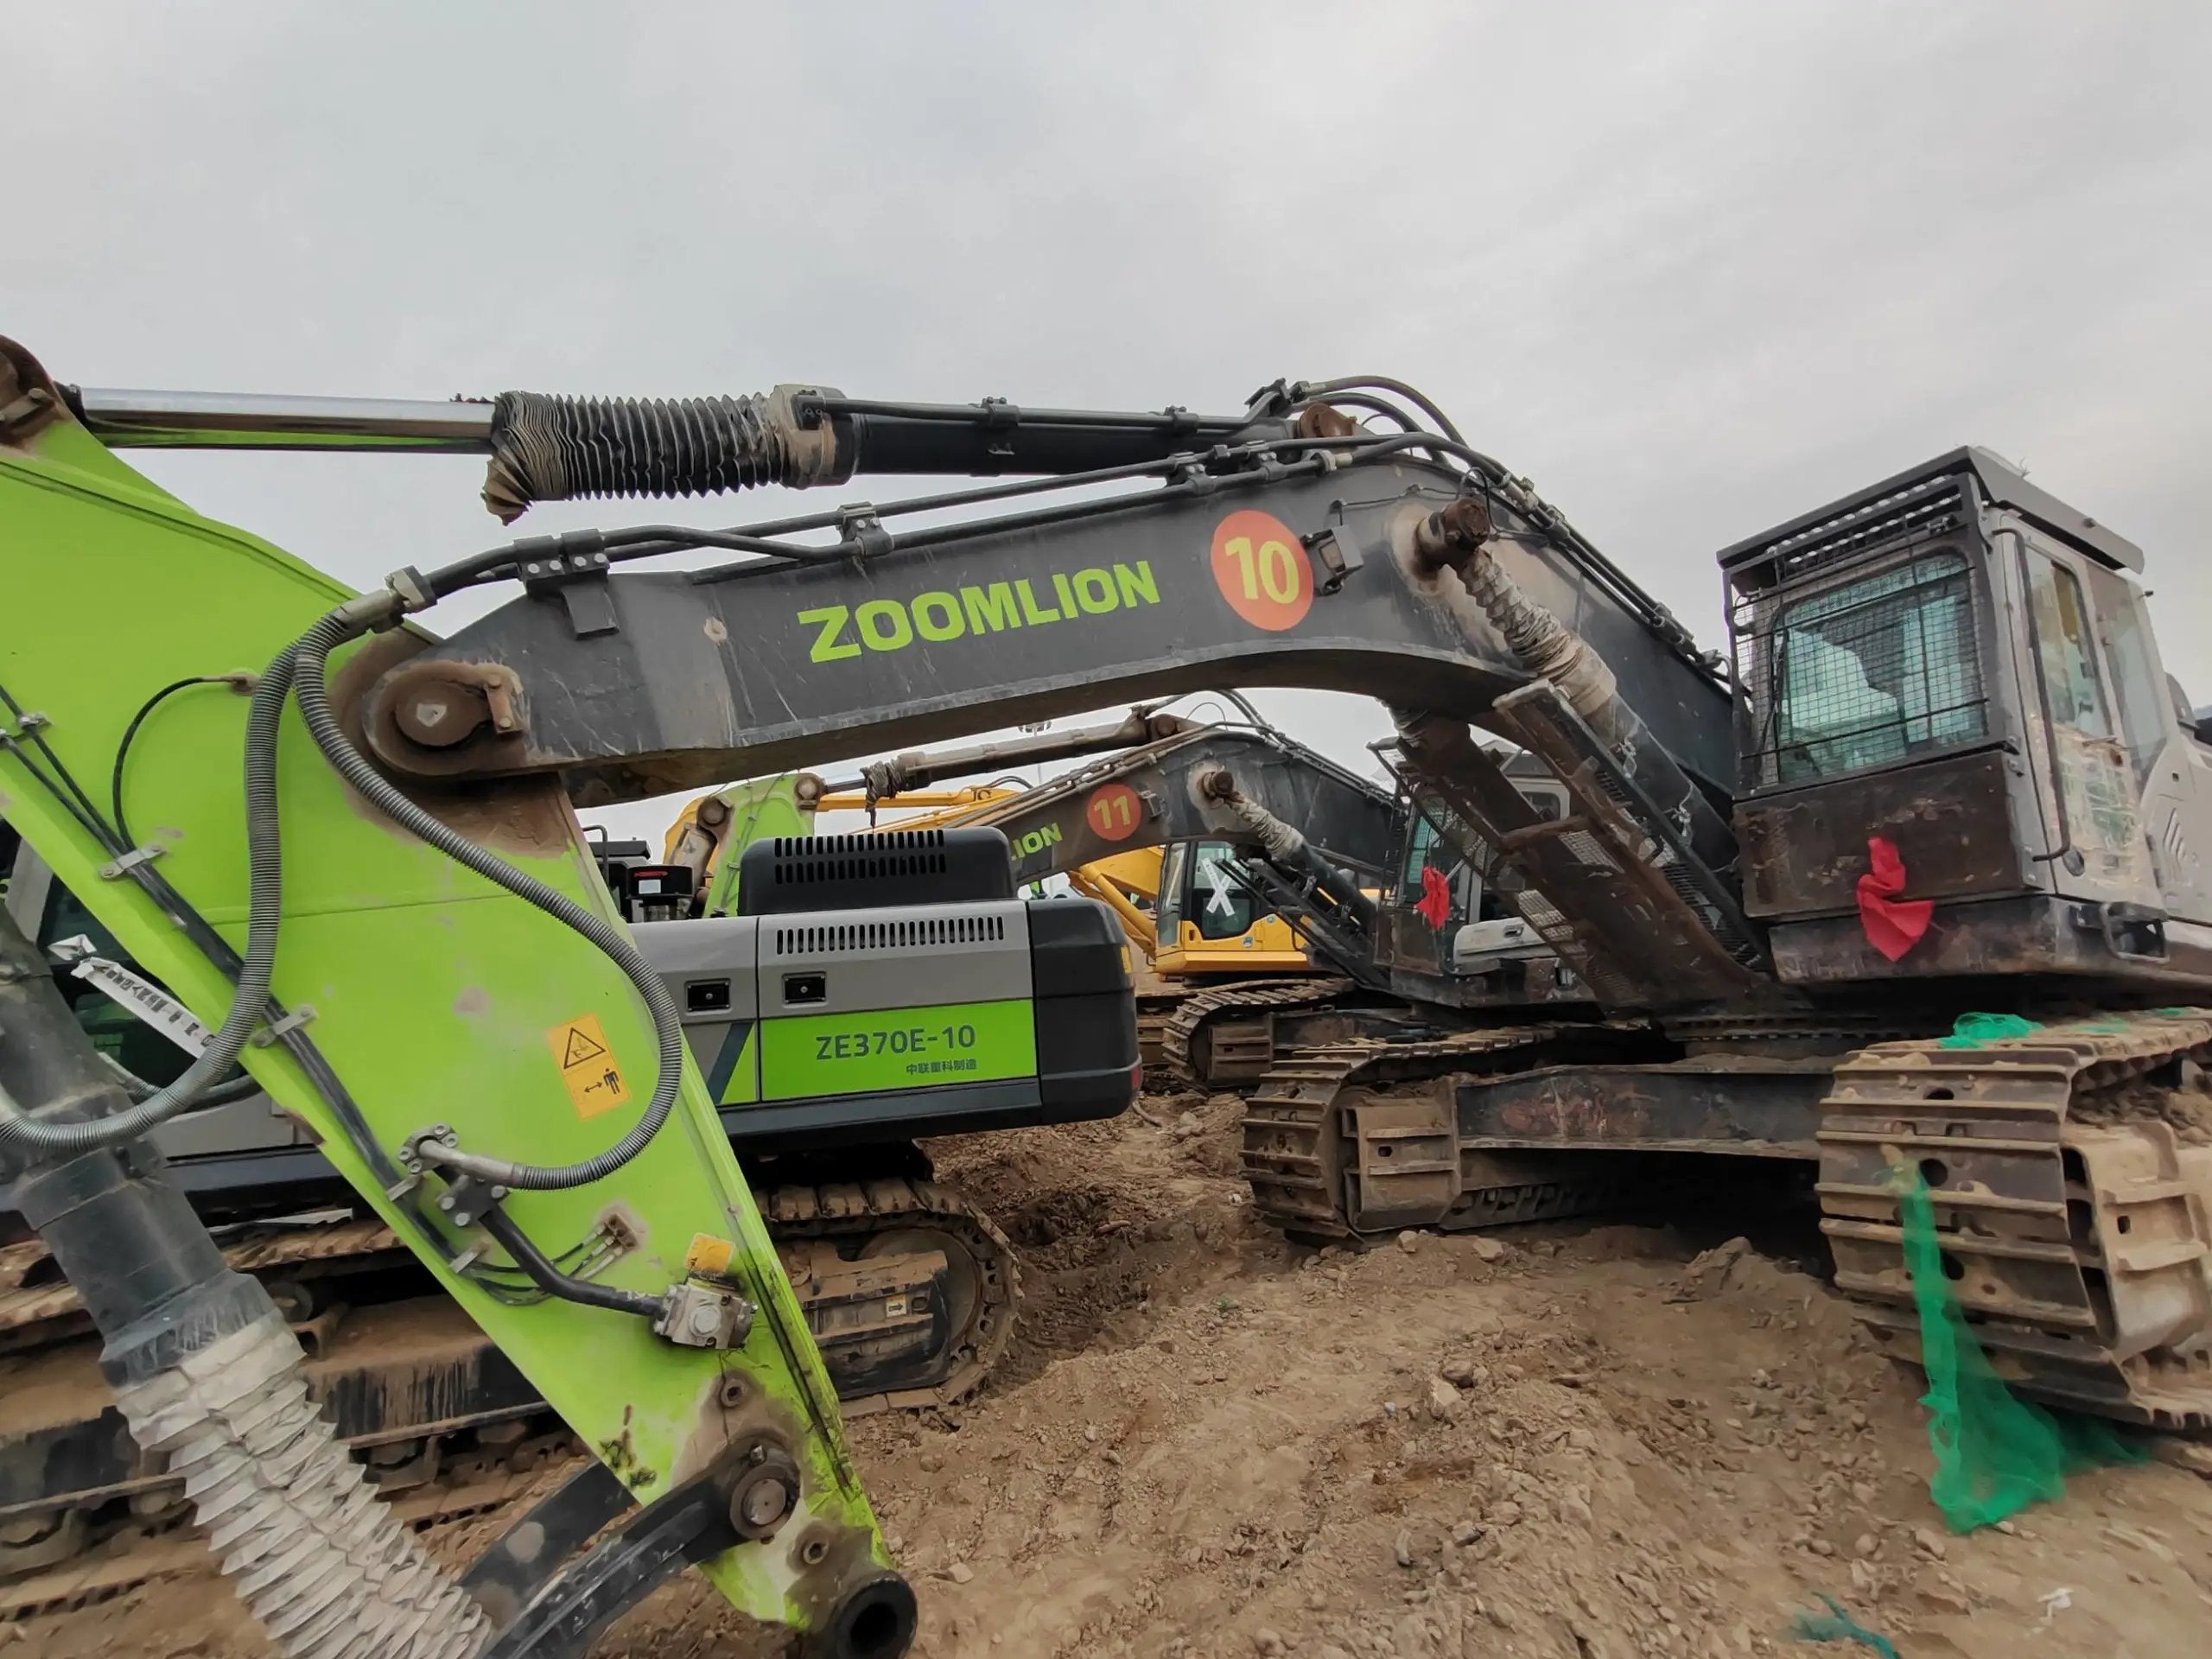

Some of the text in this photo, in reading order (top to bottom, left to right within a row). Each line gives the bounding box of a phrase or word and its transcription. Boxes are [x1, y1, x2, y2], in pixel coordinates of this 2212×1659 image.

[1224, 537, 1300, 605] 10
[797, 560, 1160, 664] ZOOMLION
[1094, 795, 1131, 830] 11
[1011, 822, 1063, 861] ION
[816, 1025, 976, 1060] ZE370E-10
[906, 1058, 976, 1075] 中联重科制造
